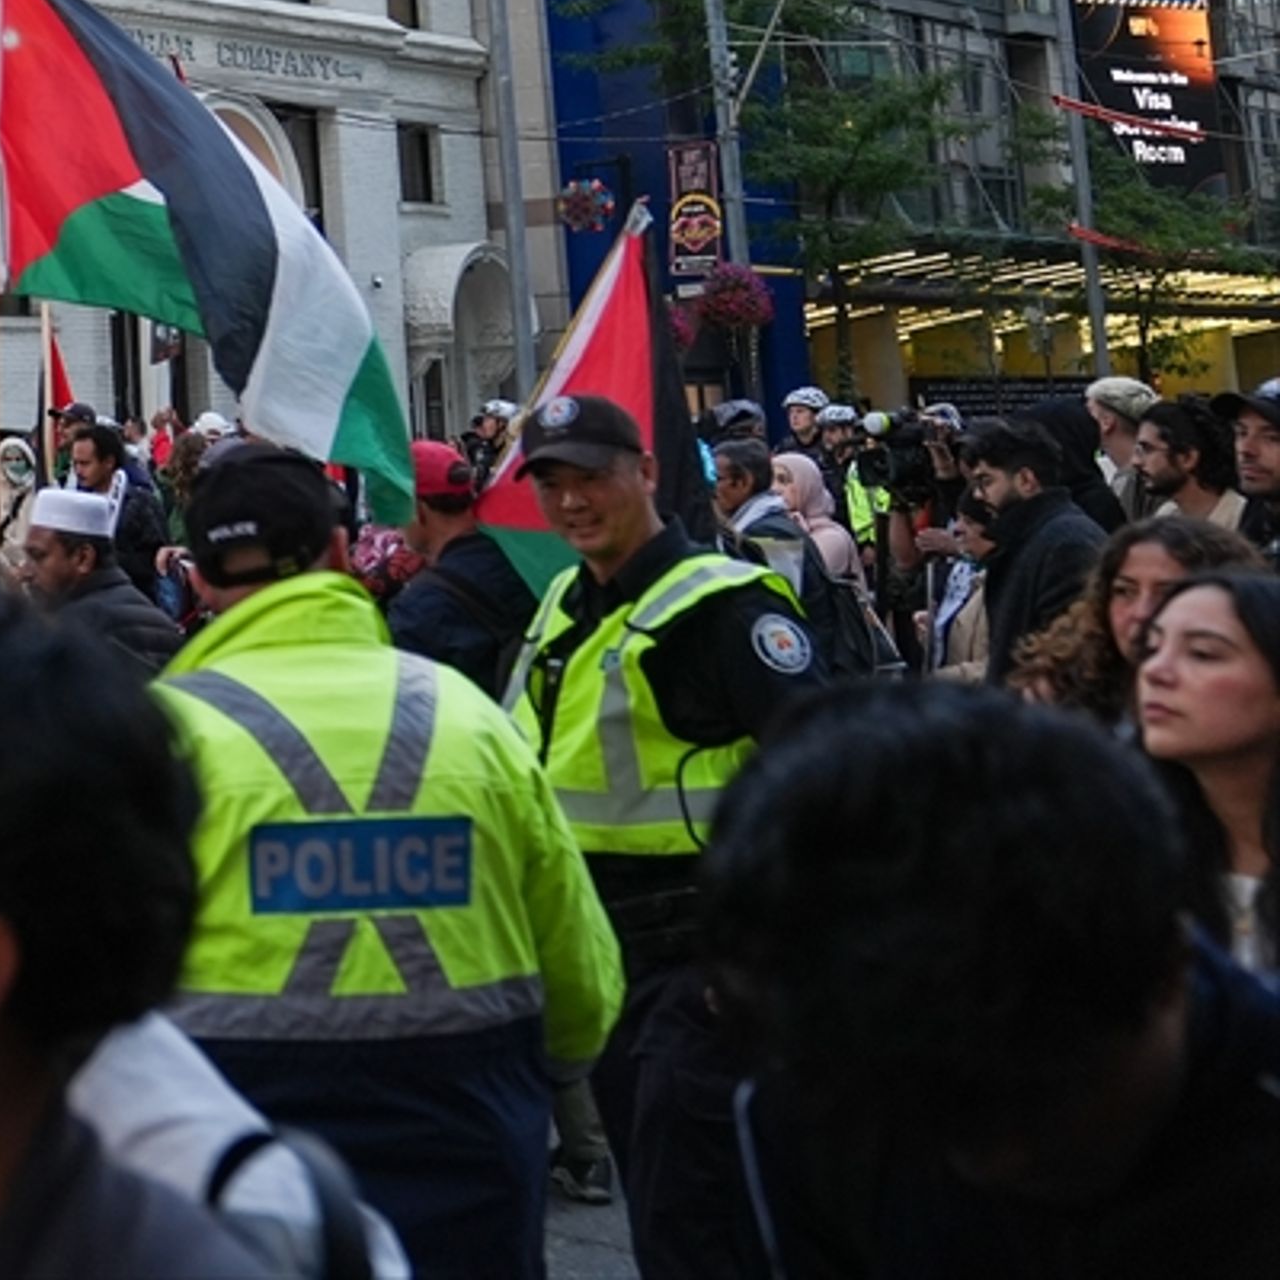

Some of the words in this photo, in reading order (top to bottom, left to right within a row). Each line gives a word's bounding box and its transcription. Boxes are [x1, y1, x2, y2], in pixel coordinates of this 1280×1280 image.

[216, 40, 333, 81] COMPANY
[1132, 86, 1172, 110] Visa
[1132, 140, 1185, 163] Room
[254, 836, 466, 899] POLICE
